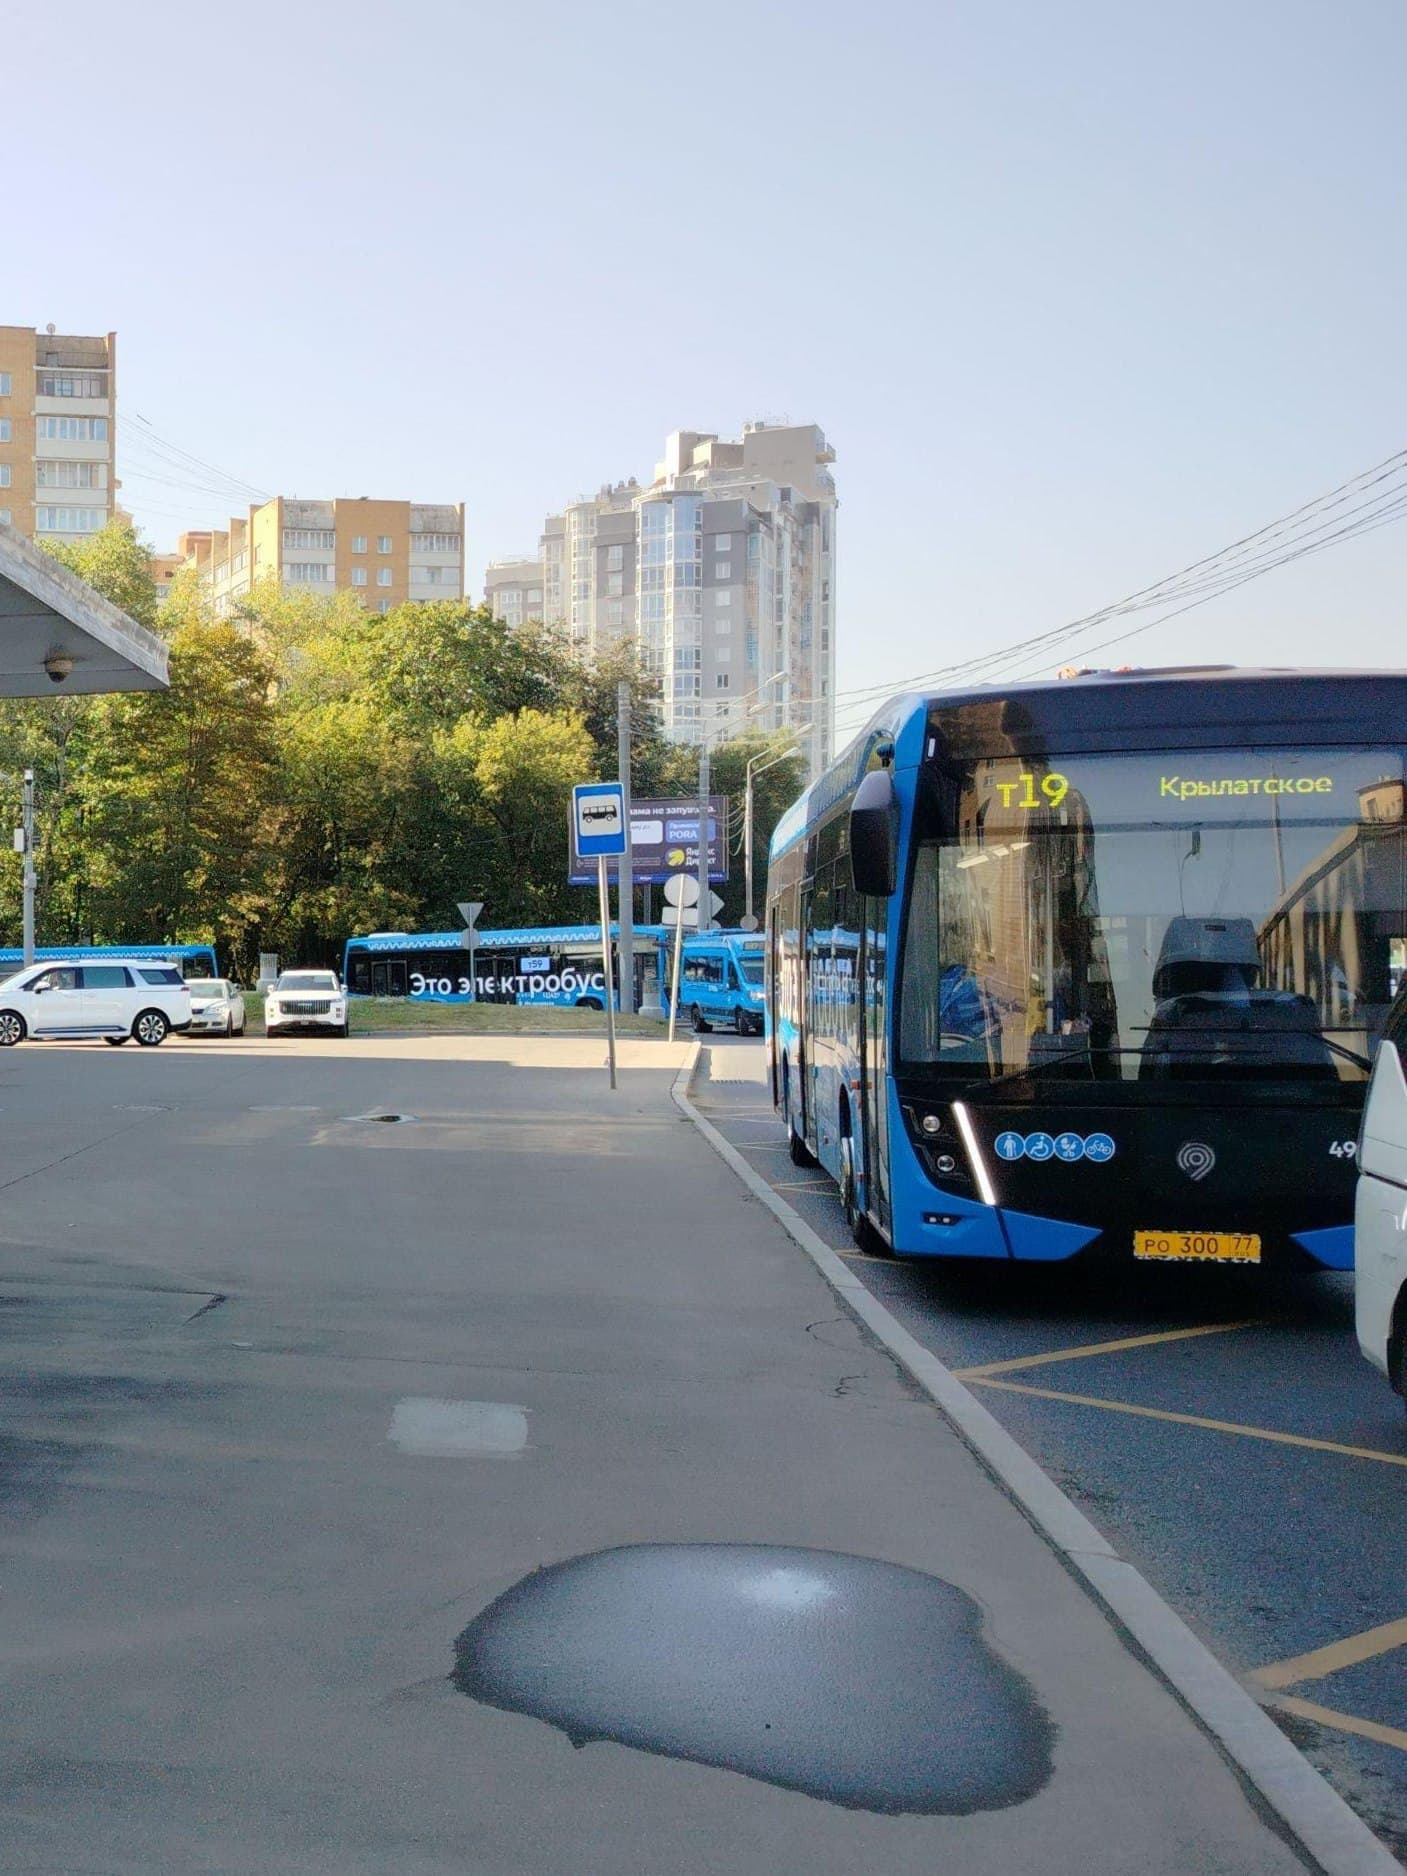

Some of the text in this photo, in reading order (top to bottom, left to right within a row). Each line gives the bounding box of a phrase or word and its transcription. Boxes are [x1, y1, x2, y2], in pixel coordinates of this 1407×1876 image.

[997, 773, 1069, 808] т19
[1160, 776, 1333, 801] Крылатское
[669, 830, 698, 839] PORA
[409, 967, 606, 998] Это электробус
[1180, 1237, 1219, 1254] 300
[1232, 1237, 1252, 1250] 77
